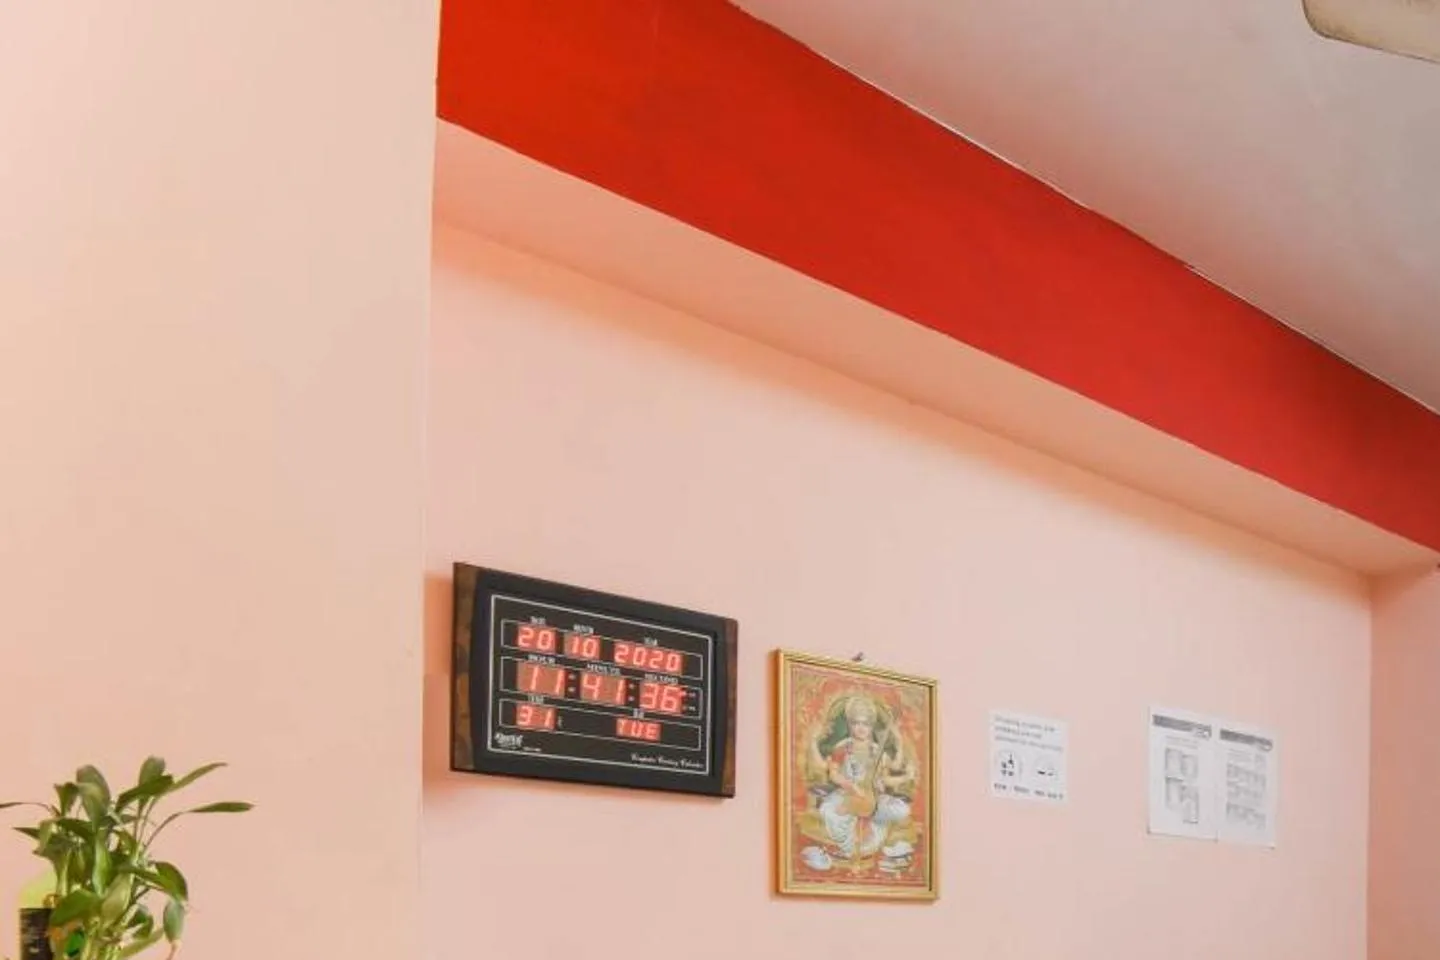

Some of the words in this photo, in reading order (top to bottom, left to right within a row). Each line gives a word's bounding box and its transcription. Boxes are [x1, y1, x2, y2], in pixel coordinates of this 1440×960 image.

[517, 626, 552, 651] 20
[571, 633, 598, 658] 10
[613, 642, 682, 672] 2020
[517, 705, 552, 729] 31
[617, 719, 660, 740] TUE
